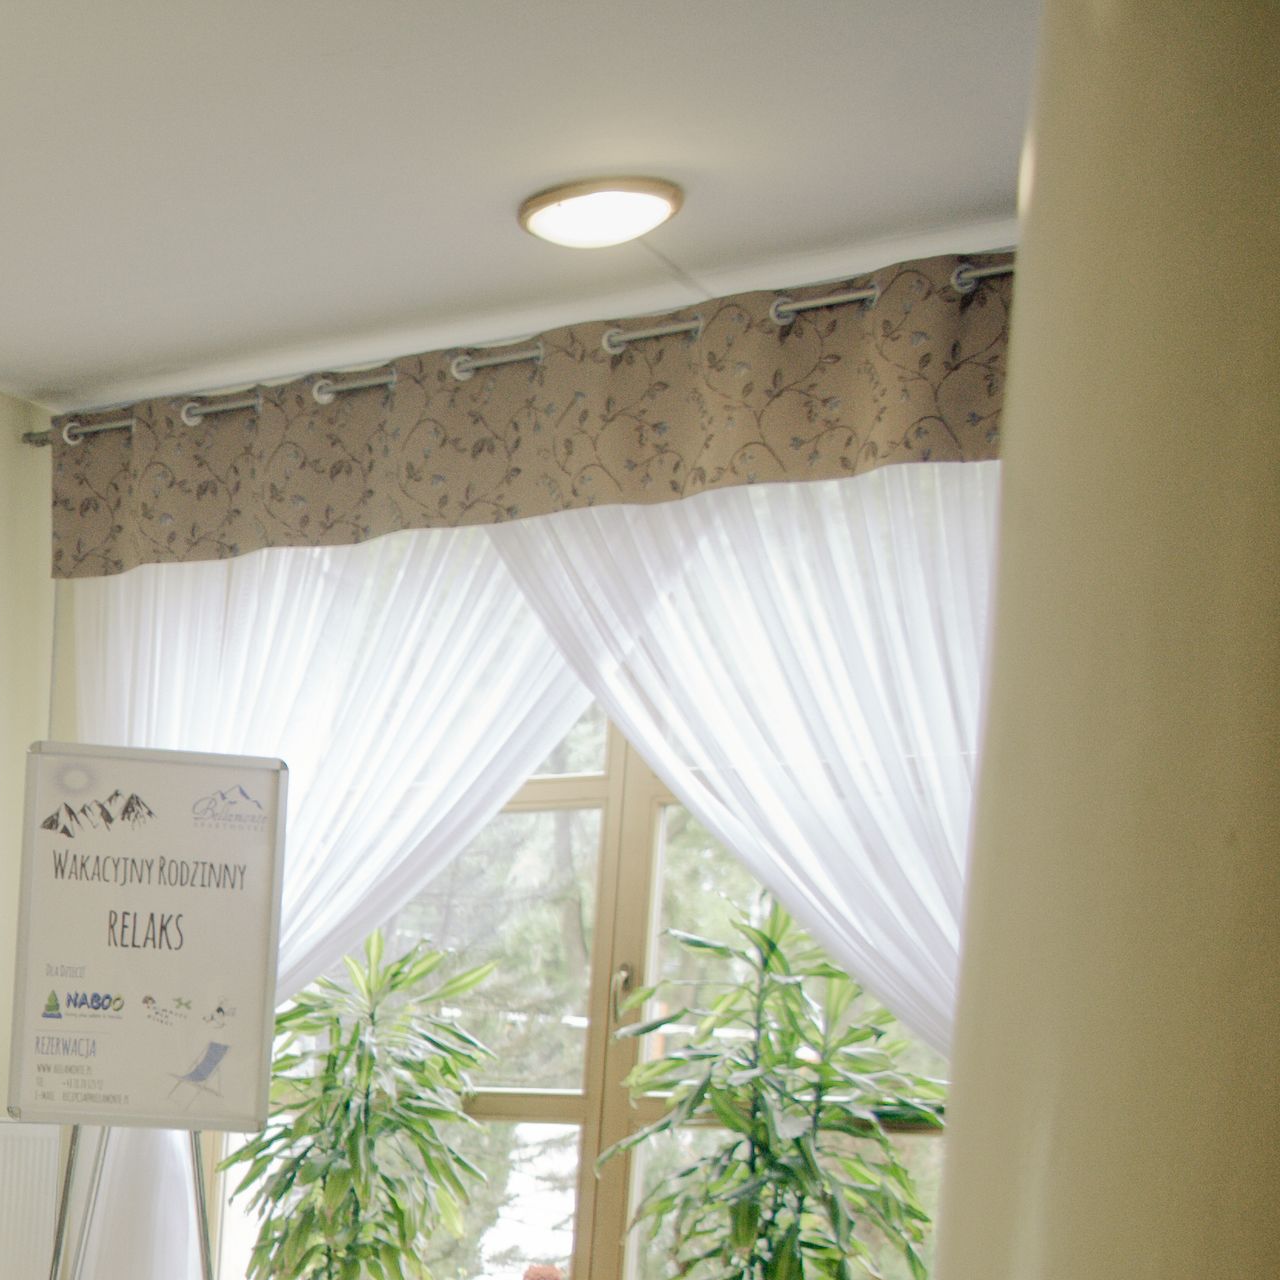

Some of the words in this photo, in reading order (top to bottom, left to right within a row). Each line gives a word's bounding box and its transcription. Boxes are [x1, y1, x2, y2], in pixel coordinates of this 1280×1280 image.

[53, 850, 154, 886] WAKACYJNY
[158, 855, 246, 890] RODZINNY
[107, 910, 184, 951] RELAKS
[66, 991, 125, 1012] NABOO
[35, 1036, 97, 1058] REZERWACJA
